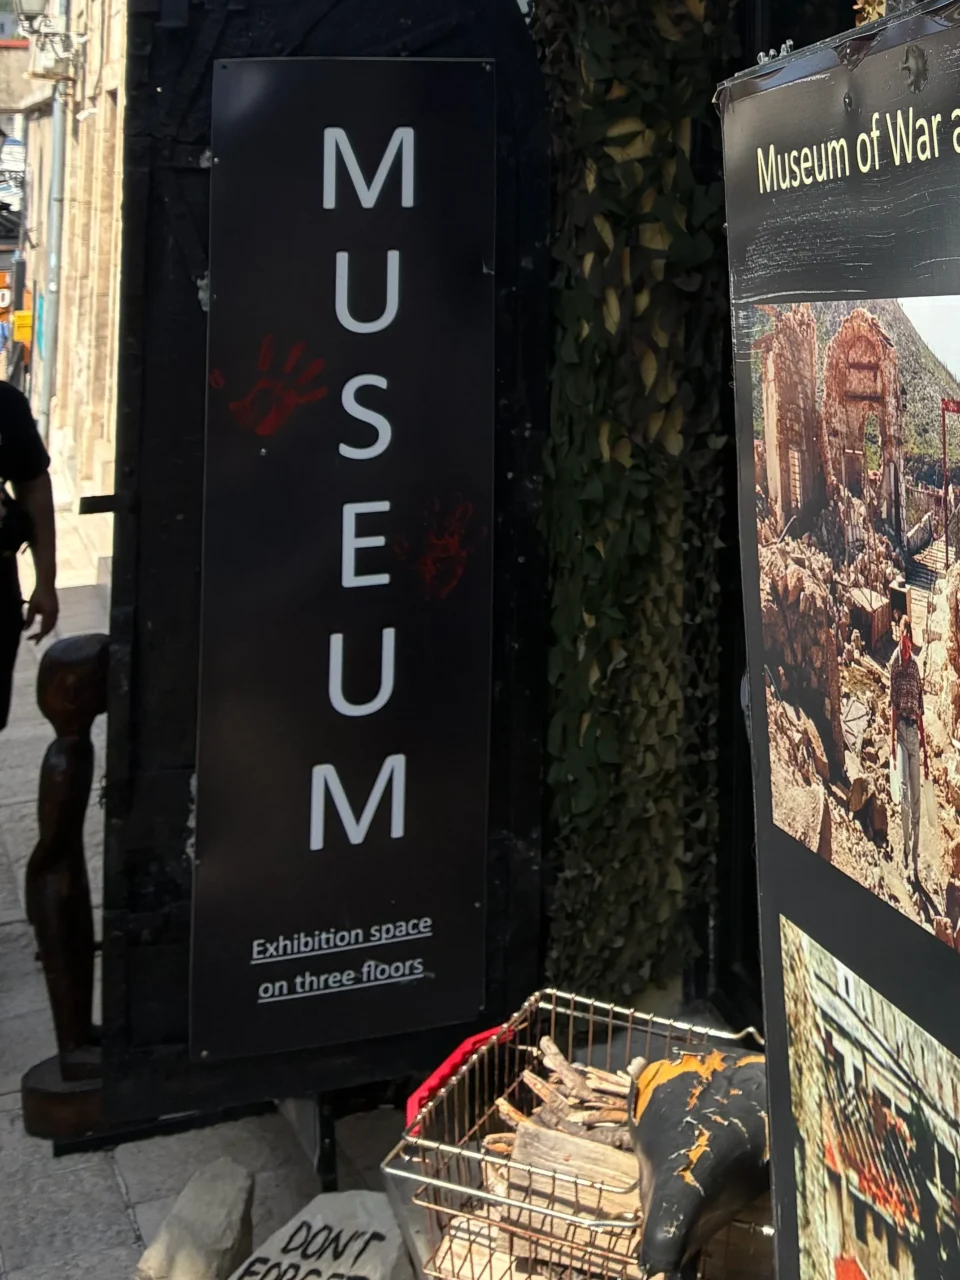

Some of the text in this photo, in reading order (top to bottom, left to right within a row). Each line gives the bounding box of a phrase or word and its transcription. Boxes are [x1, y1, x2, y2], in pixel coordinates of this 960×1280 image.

[756, 131, 851, 194] Museum
[856, 111, 882, 174] of
[885, 106, 943, 166] War
[309, 125, 416, 852] MUSEUM
[251, 916, 433, 963] Exhibition space
[258, 957, 425, 1001] on three floors
[280, 1219, 387, 1269] DON'T
